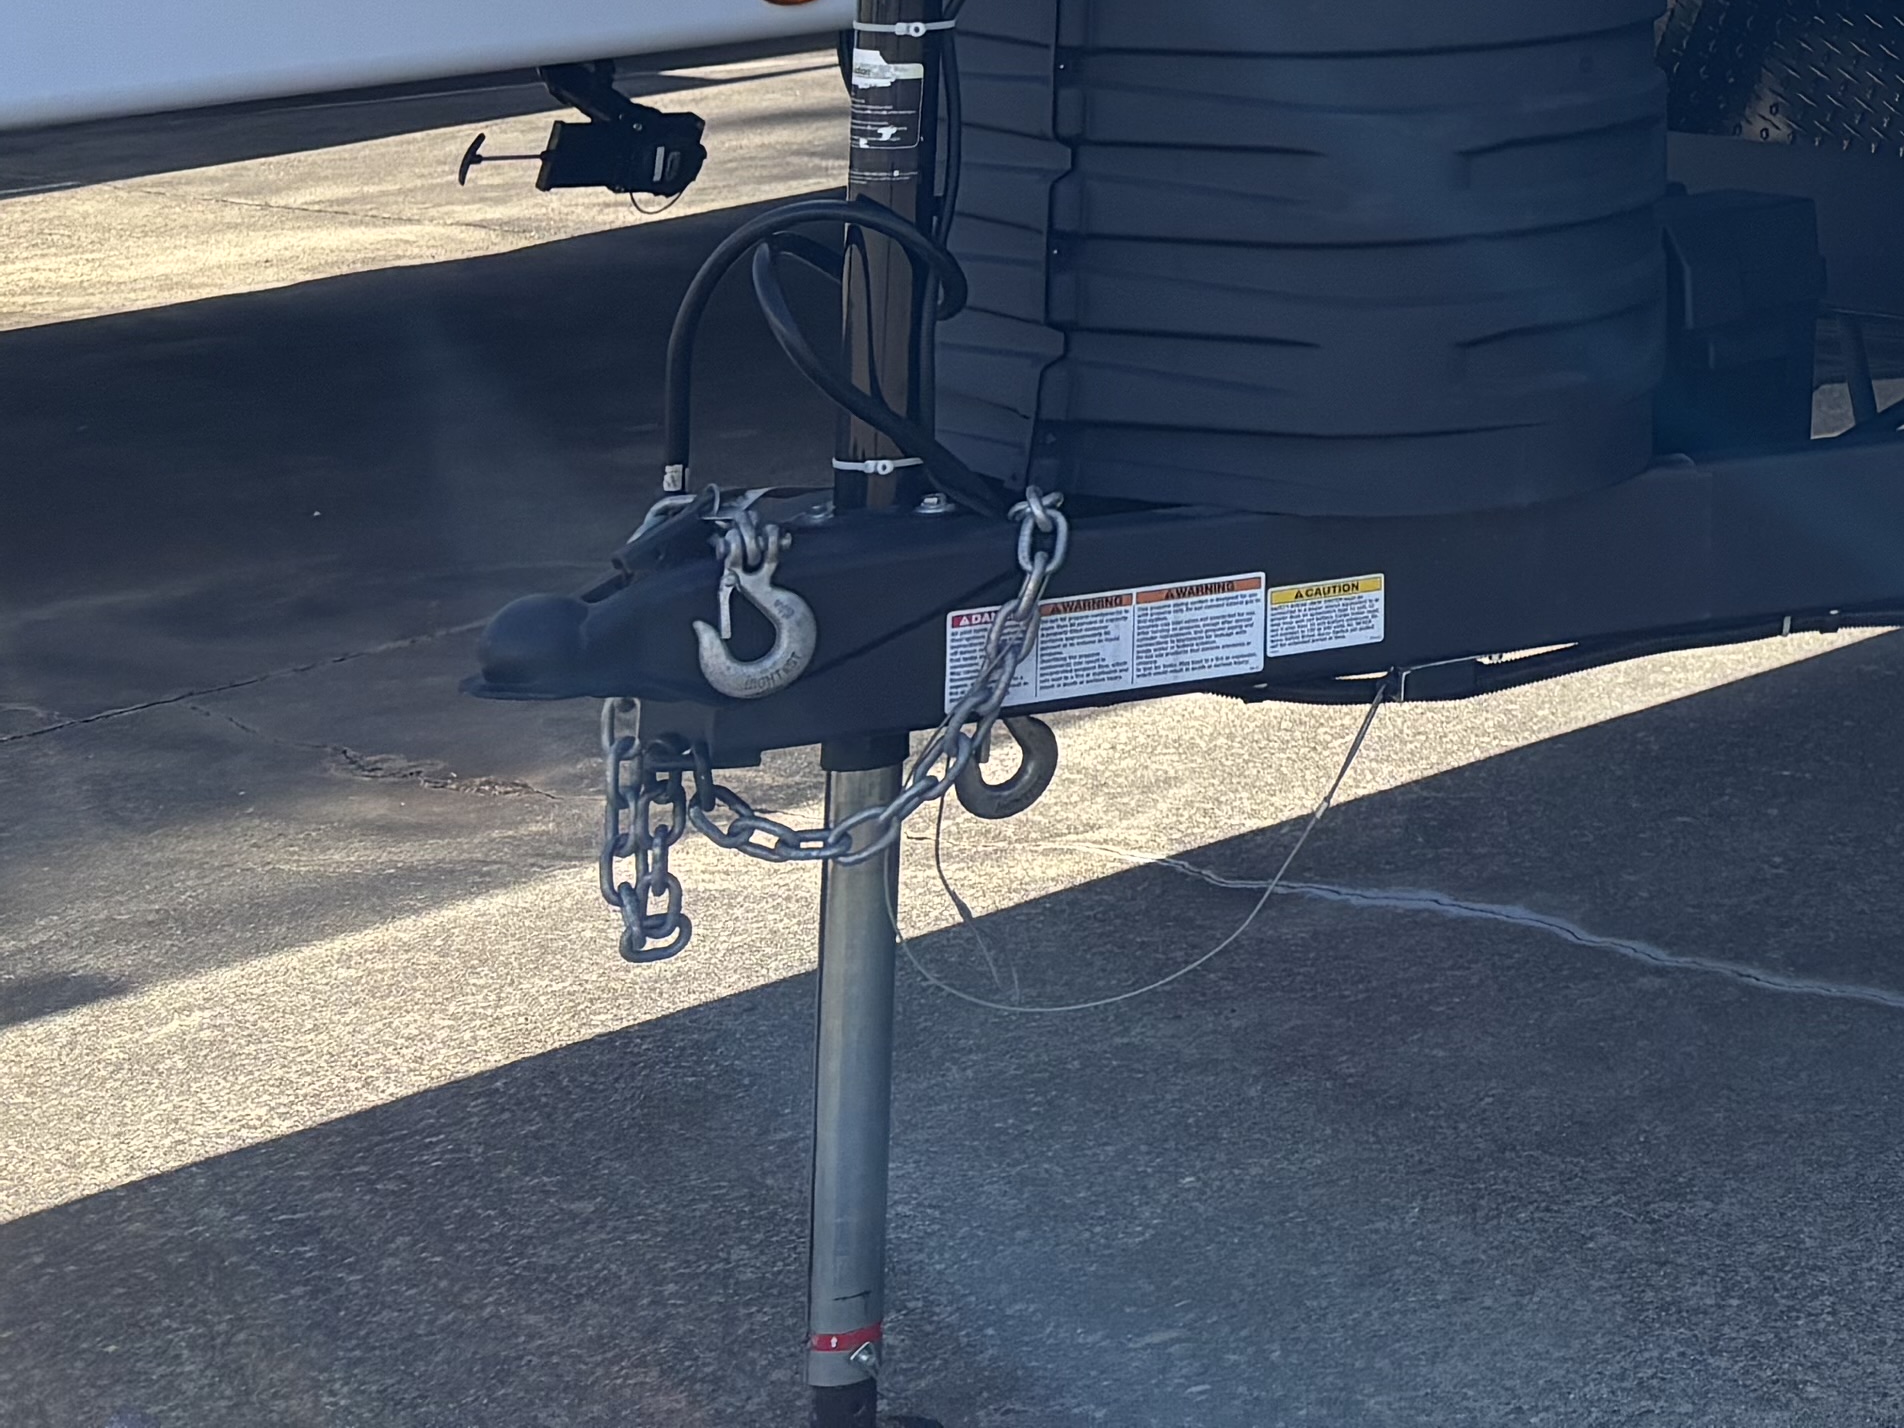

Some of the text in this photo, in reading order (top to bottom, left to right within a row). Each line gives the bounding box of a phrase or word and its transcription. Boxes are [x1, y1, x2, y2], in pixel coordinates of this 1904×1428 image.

[1176, 580, 1236, 599] WARNING
[1304, 581, 1360, 598] CAUTION
[1061, 596, 1124, 614] WARNING
